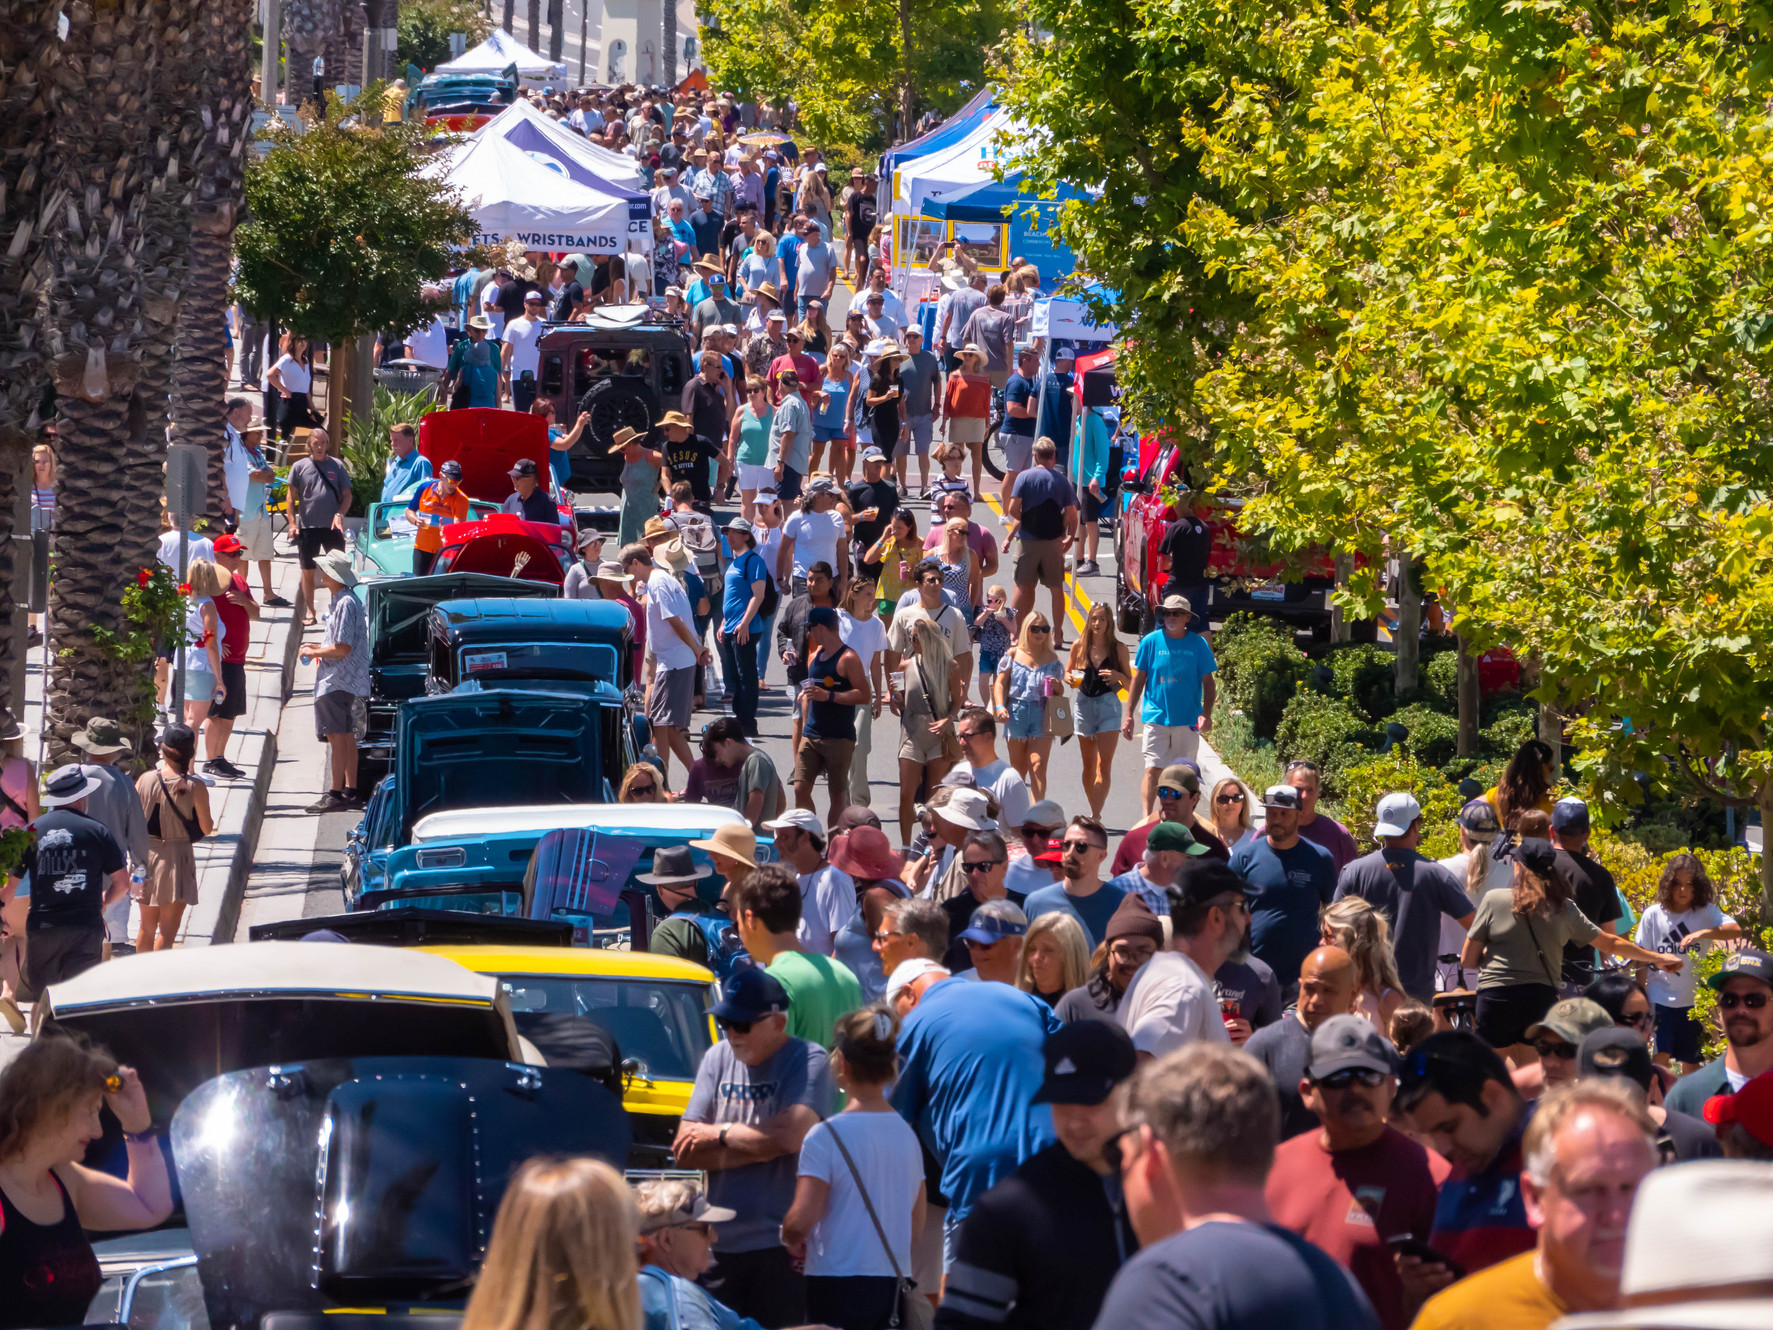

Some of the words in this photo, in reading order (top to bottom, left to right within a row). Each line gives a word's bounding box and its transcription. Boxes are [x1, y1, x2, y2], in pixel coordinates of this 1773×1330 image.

[628, 221, 648, 233] CE
[473, 233, 499, 245] ETS
[517, 233, 617, 248] WRISTBANDS
[668, 451, 698, 465] JESUS
